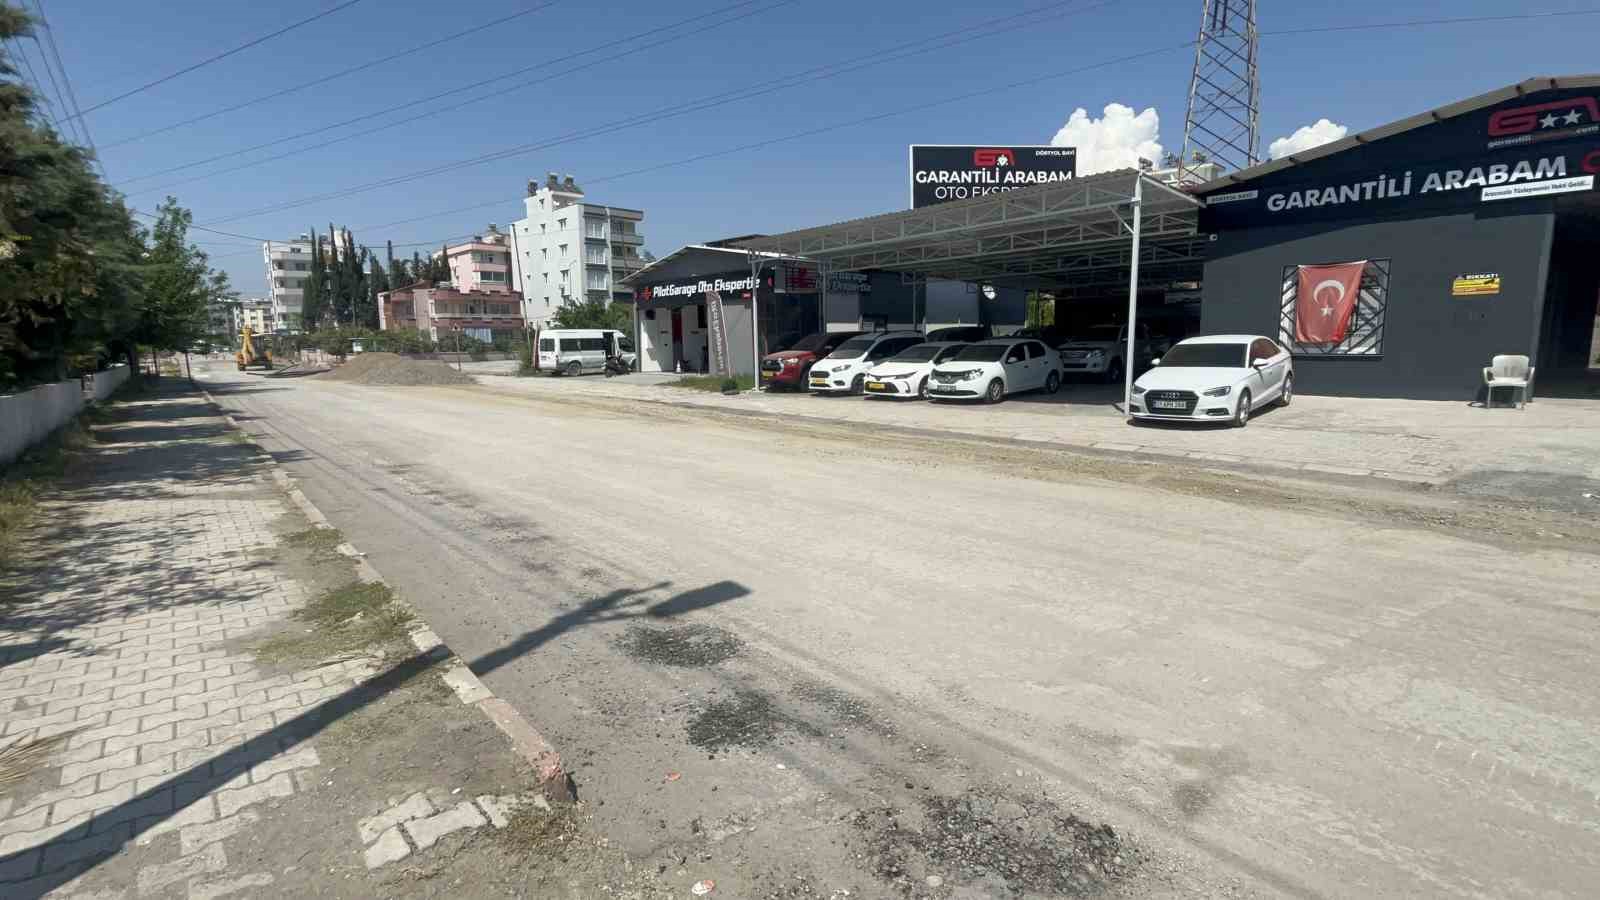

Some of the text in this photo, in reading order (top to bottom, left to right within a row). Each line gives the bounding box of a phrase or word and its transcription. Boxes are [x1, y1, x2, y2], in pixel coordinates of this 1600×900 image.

[915, 168, 1072, 184] GARANTİLİ ARABAM
[1267, 171, 1412, 212] GARANTİLİ
[1420, 155, 1567, 193] ARABAM
[935, 186, 968, 200] OTO
[653, 284, 697, 298] PilotGarage
[698, 280, 713, 293] Oto
